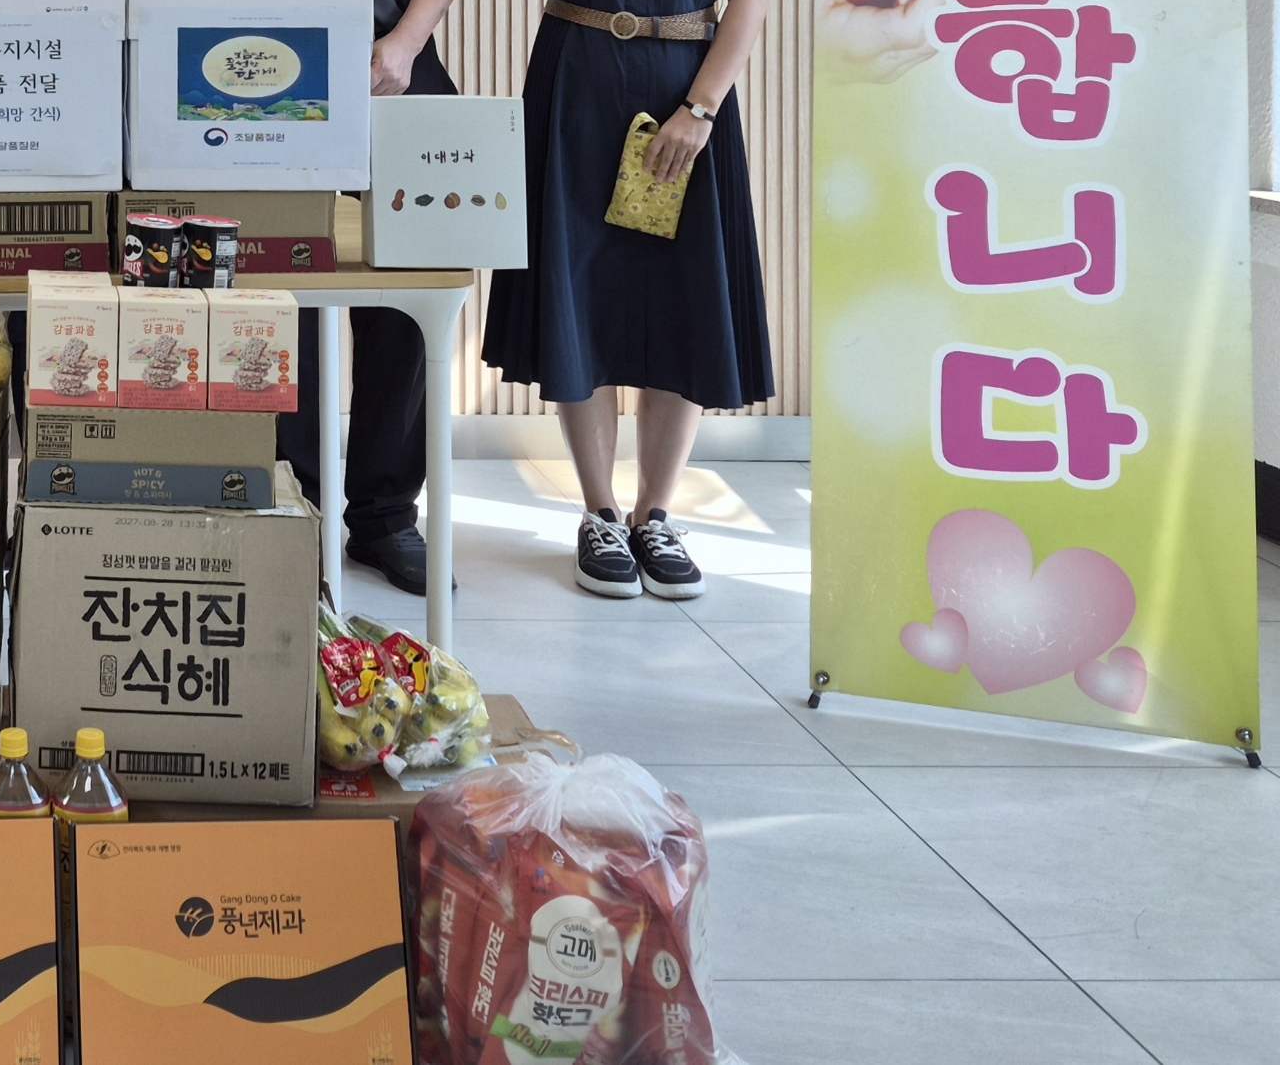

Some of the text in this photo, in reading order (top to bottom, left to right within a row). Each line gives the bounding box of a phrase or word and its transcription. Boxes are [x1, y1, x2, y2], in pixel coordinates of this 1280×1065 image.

[19, 73, 60, 94] 전달
[30, 106, 61, 122] 간식)
[234, 132, 285, 142] 조달품질원
[134, 468, 153, 478] HOT
[131, 479, 165, 490] SPICY
[54, 526, 94, 536] LOTTE
[102, 554, 233, 573] 정성껏 밥알을 걸러 깔끔한
[82, 587, 246, 647] 잔치집
[121, 649, 229, 706] 식혜
[220, 894, 302, 906] Gang Dong O Cake
[219, 908, 305, 938] 풍년제과
[480, 922, 505, 986] 크리스피
[556, 933, 597, 963] 고메
[529, 974, 609, 1009] 크리스피
[533, 1000, 593, 1027] 핫도그
